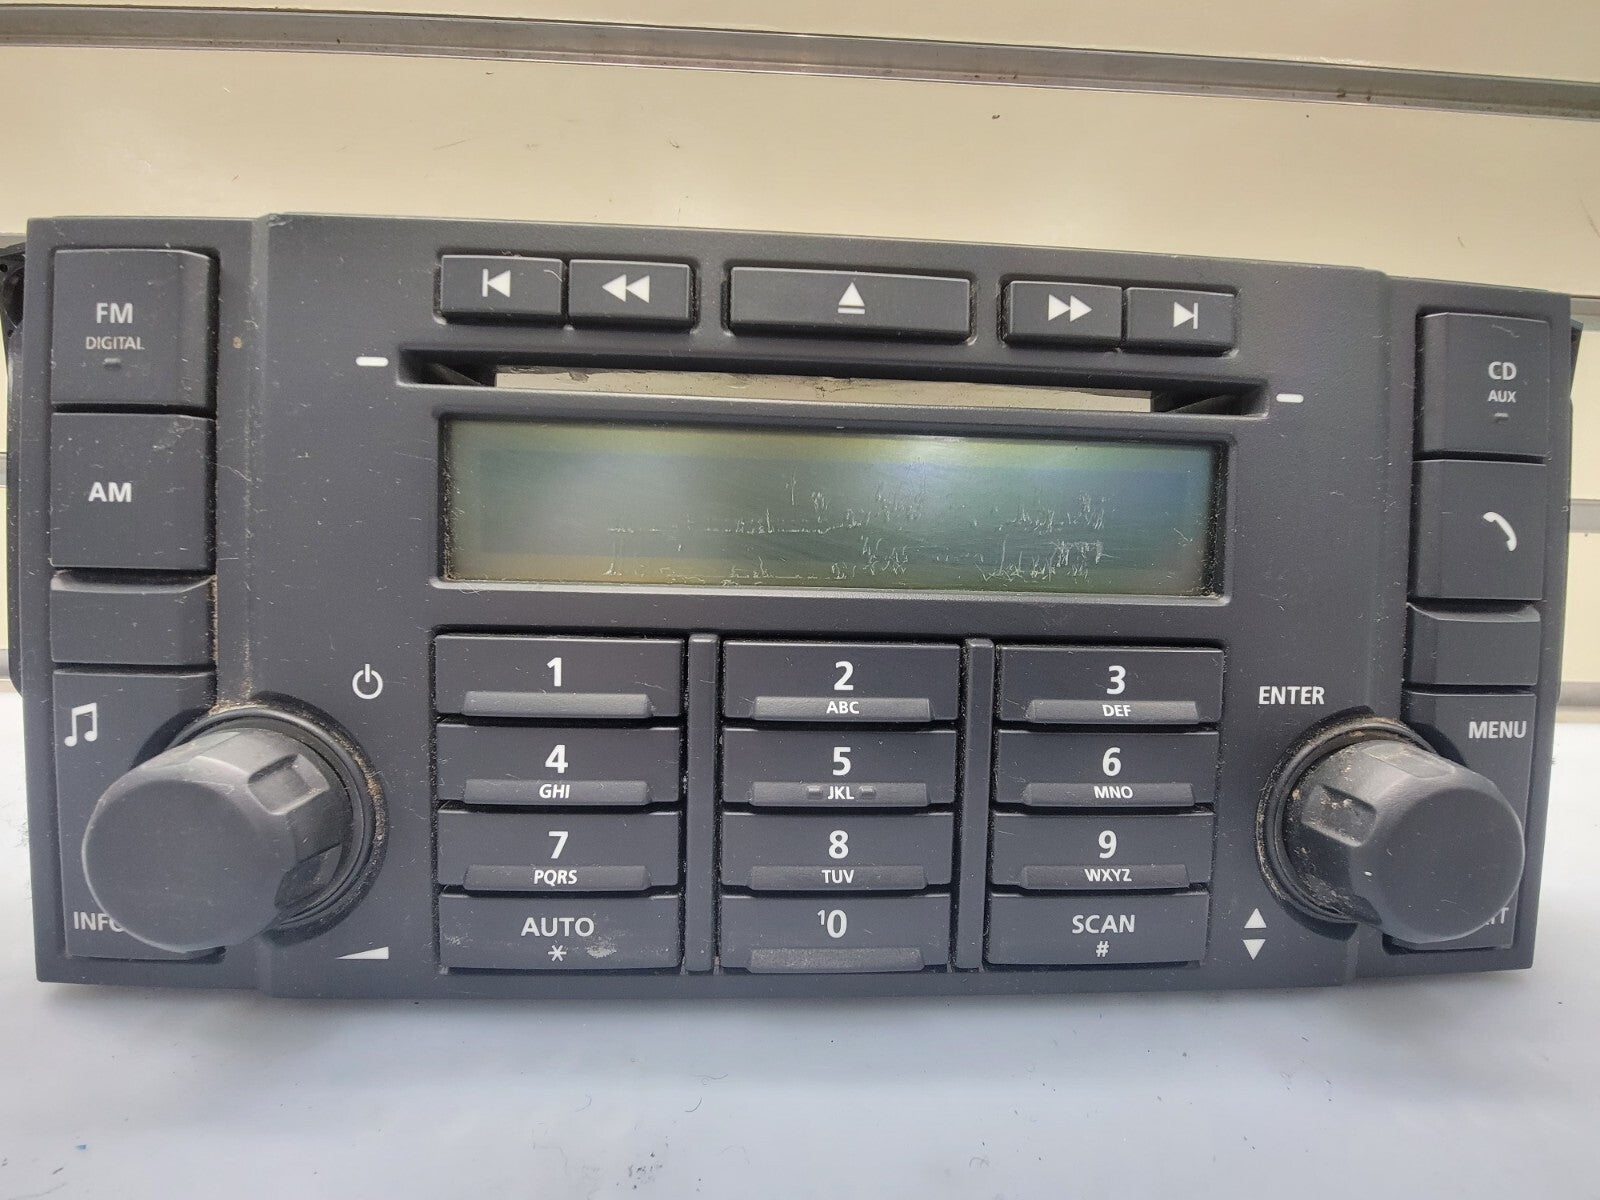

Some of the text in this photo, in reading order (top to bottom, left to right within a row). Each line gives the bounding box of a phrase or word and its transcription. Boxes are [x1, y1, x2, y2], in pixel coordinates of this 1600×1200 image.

[96, 302, 133, 324] FM
[85, 335, 145, 351] DIGITAL
[1488, 361, 1517, 381] CD
[1487, 389, 1517, 403] AUX
[88, 481, 132, 503] AM
[546, 657, 562, 687] 1
[833, 661, 854, 691] 2
[1106, 665, 1126, 695] 3
[1258, 685, 1325, 705] ENTER
[826, 701, 860, 715] ABC
[1101, 704, 1132, 717] DEF
[1468, 720, 1527, 739] MENU
[545, 744, 569, 774] 4
[832, 746, 852, 776] 5
[1102, 747, 1122, 777] 6
[538, 783, 571, 799] GHI
[827, 787, 855, 800] JKL
[1093, 785, 1134, 799] MNO
[548, 830, 569, 859] 7
[828, 830, 849, 859] 8
[1098, 830, 1117, 859] 9
[533, 869, 578, 887] PQRS
[821, 869, 855, 884] TUV
[1083, 868, 1133, 882] WXYZ
[520, 917, 595, 938] AUTO
[1071, 914, 1136, 934] SCAN
[1095, 940, 1110, 958] #
